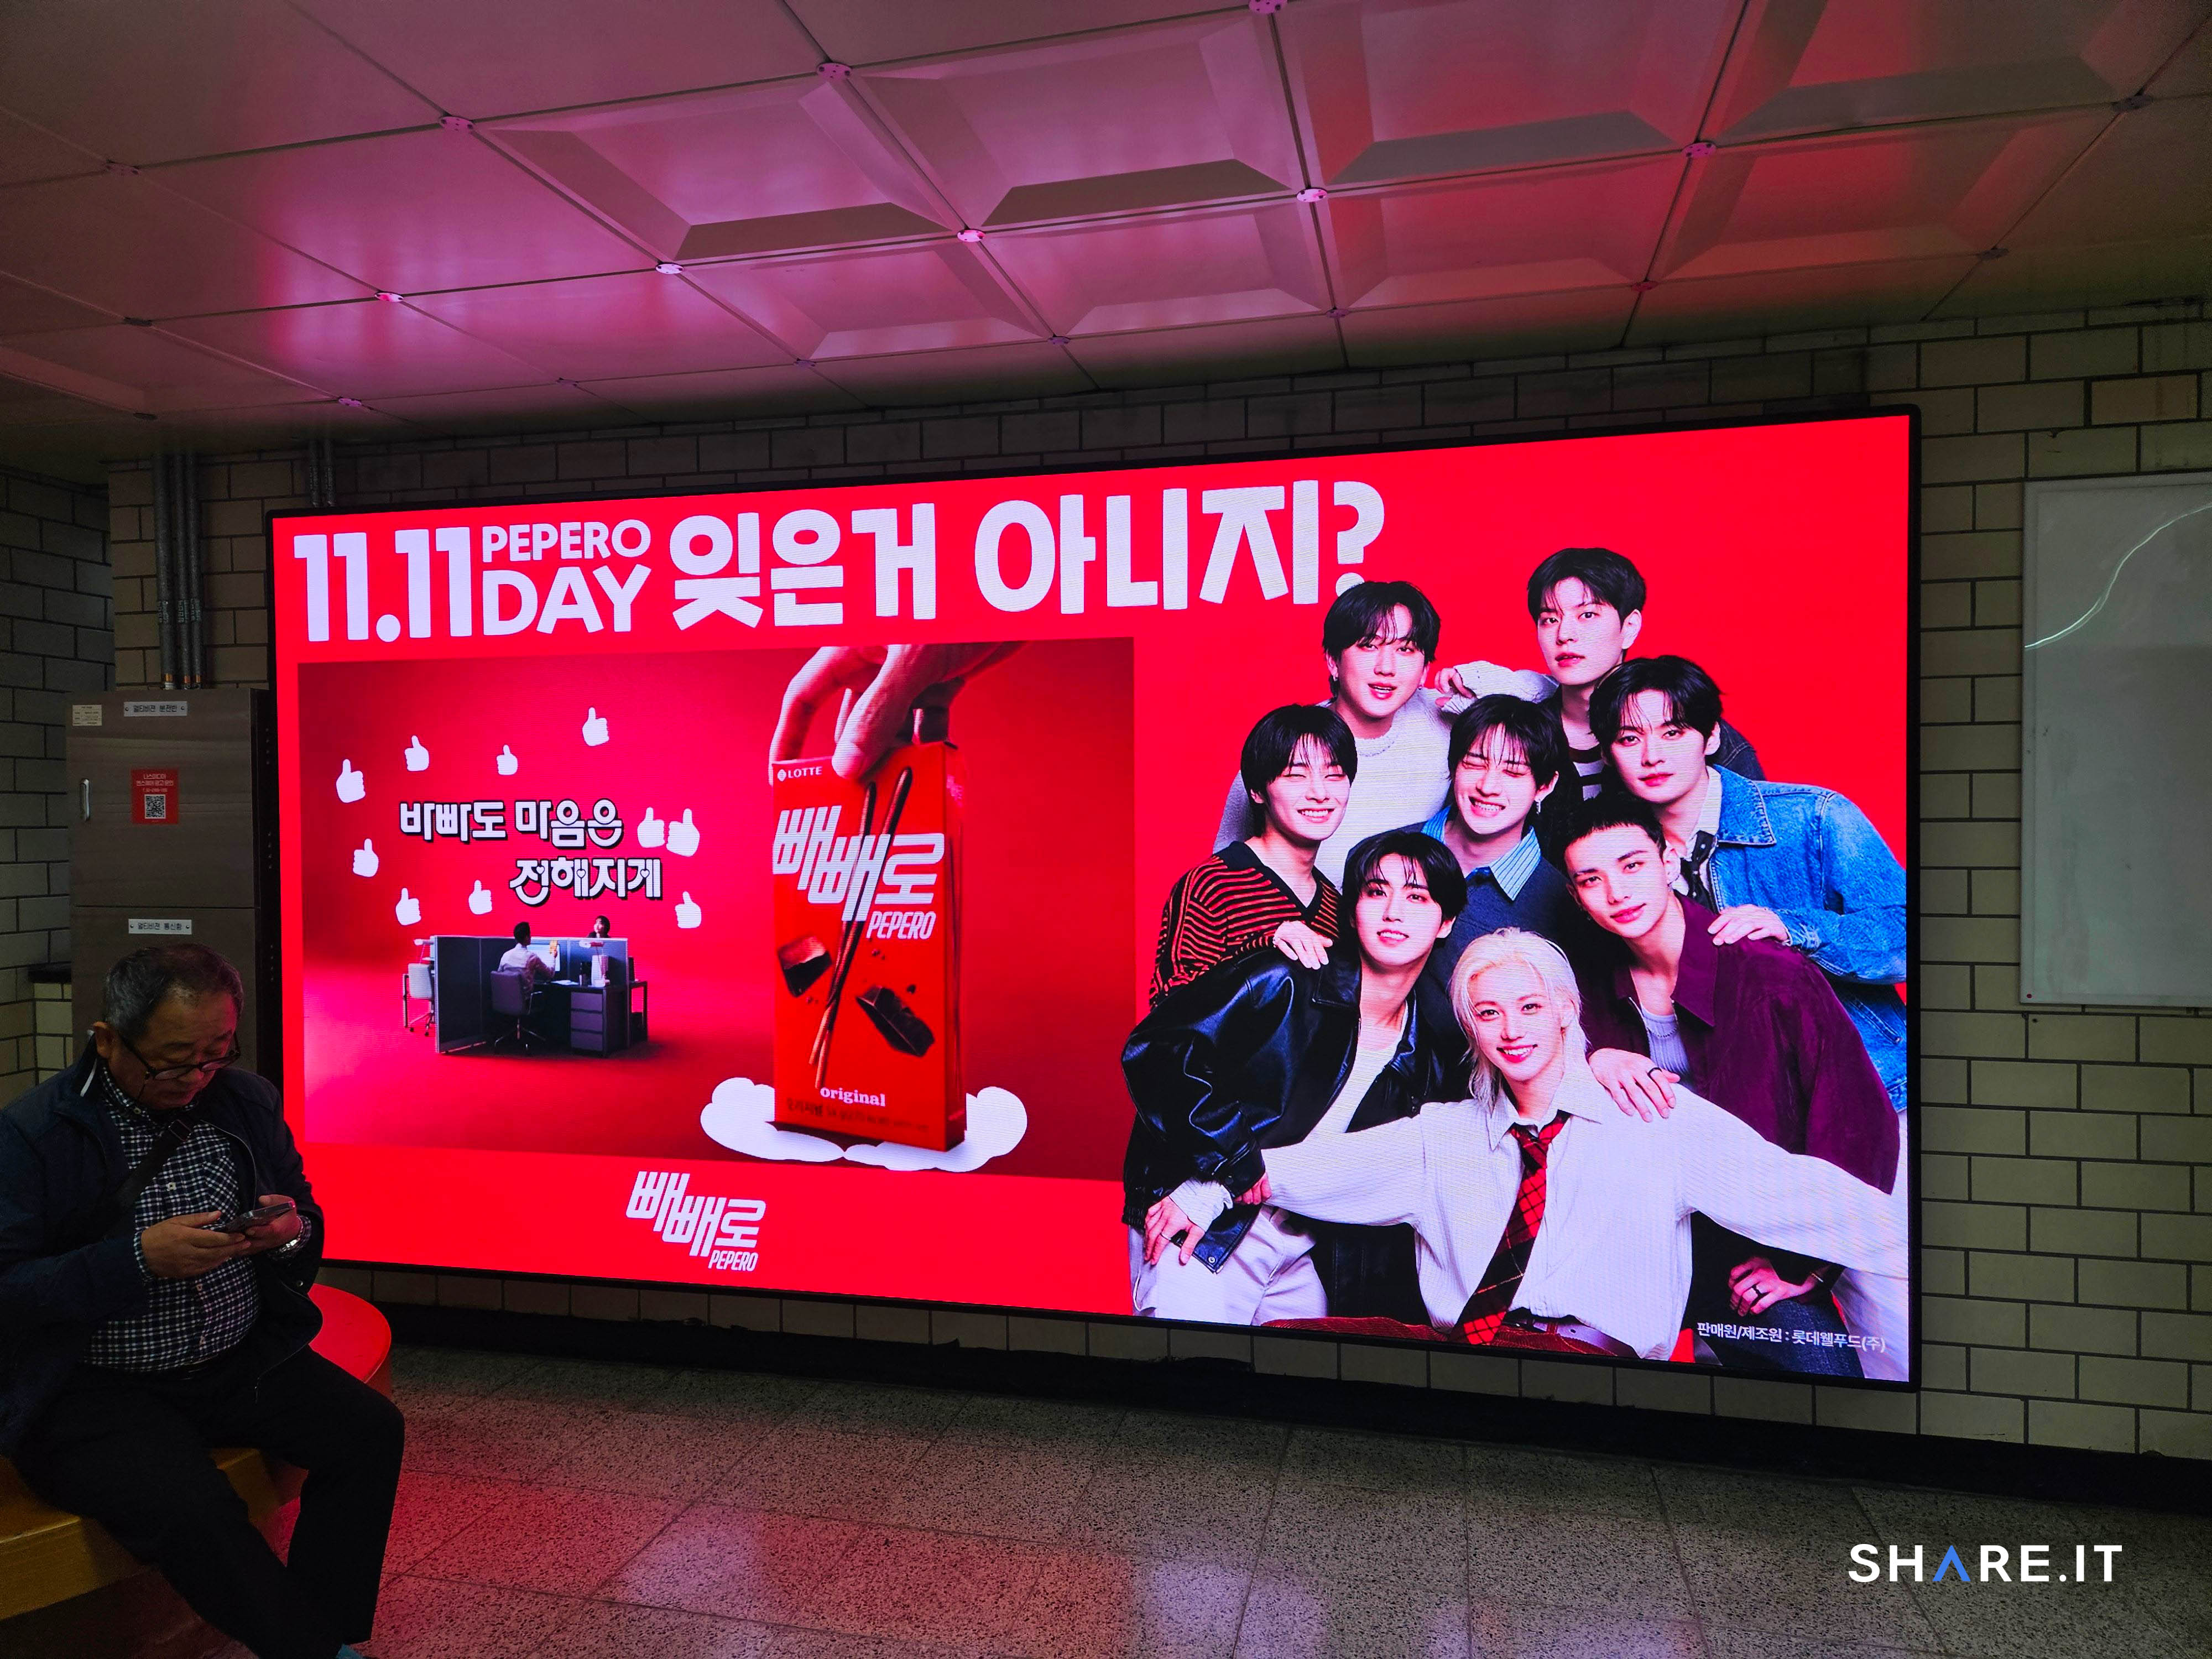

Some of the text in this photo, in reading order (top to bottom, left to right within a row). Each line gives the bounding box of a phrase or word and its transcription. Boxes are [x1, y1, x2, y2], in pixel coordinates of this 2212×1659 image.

[482, 519, 651, 562] PEPERO
[669, 479, 1385, 630] 잊은거 아니지?
[294, 526, 472, 642] 11.11
[483, 564, 651, 635] DAY
[787, 766, 823, 779] LOTTE
[399, 799, 623, 849] 바빠도 마음은
[509, 857, 662, 906] 전해지게
[772, 805, 945, 921] 빼빼로
[865, 911, 936, 940] PEPERO
[820, 1087, 886, 1107] original
[625, 1171, 766, 1257] 빼빼로
[708, 1249, 759, 1271] PEPERO
[1697, 1322, 1782, 1343] 판매원/제조원
